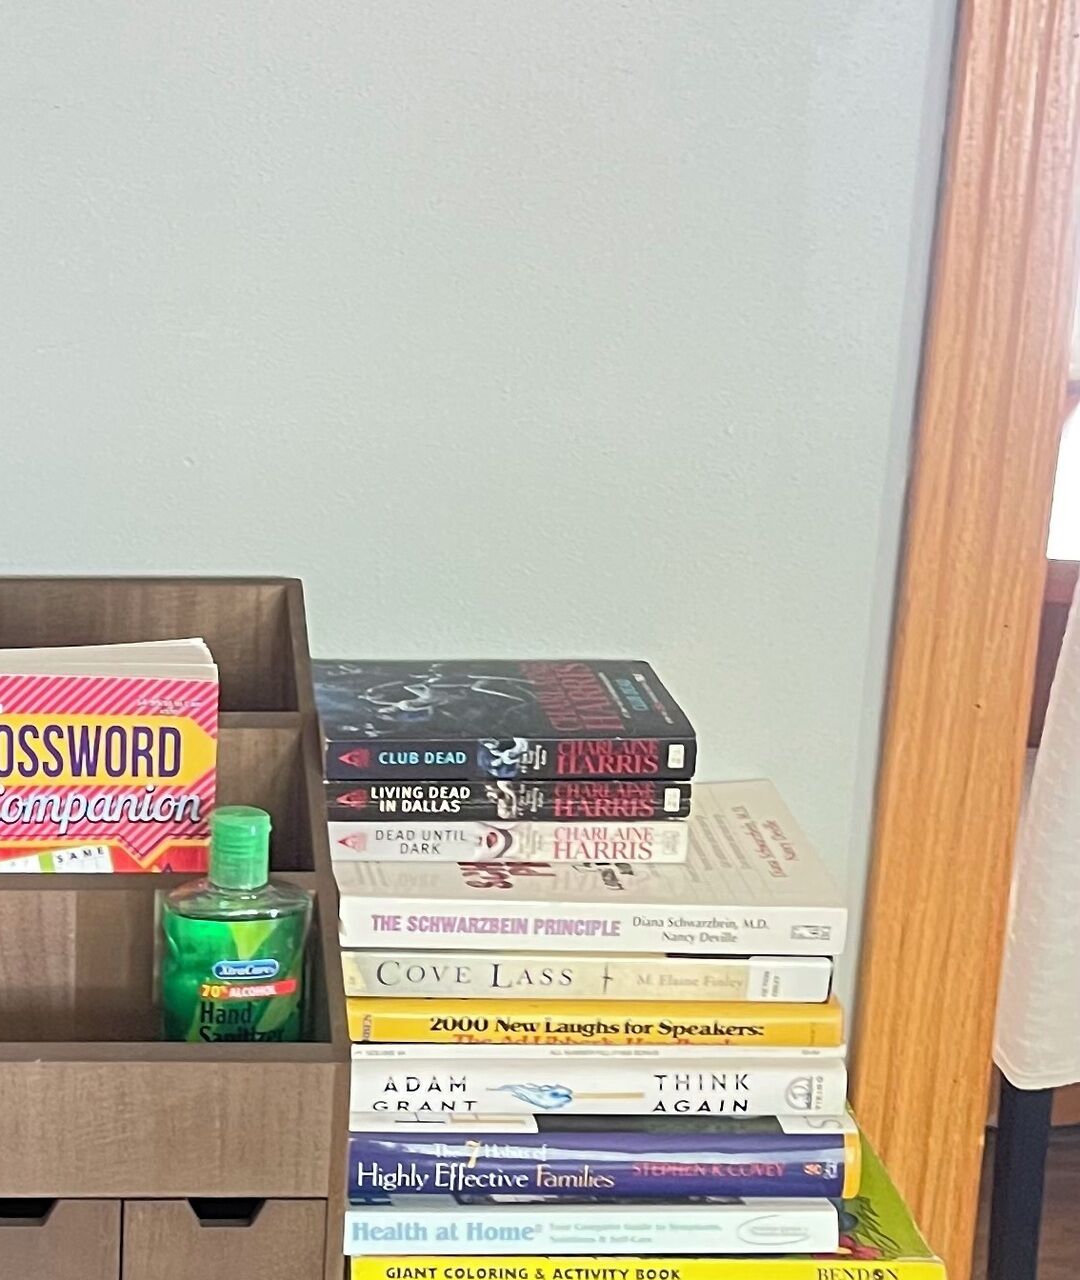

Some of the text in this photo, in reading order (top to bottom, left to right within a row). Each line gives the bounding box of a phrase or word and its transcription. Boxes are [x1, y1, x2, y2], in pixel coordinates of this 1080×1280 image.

[558, 739, 660, 756] CHARLAINE
[378, 751, 467, 765] CLUB DEAD
[556, 754, 659, 775] HARRIS
[371, 786, 471, 800] LIVING DEAD
[554, 782, 655, 799] CHARLAINE
[379, 800, 462, 813] IN DALLAS
[553, 797, 655, 818] HARRIS
[375, 829, 468, 842] DEAD UNTIL
[554, 826, 654, 841] CHARLAINE
[57, 846, 105, 864] SAME
[400, 842, 442, 855] DARK
[553, 840, 653, 860] HARRIS
[371, 914, 621, 938] THE SCHWARZBEIN PRINCIPLE
[632, 916, 665, 928] Diana
[743, 919, 770, 930] M.D.
[662, 932, 738, 945] Nancy Deville
[376, 960, 574, 989] COVE LASS
[659, 974, 700, 987] Elaine
[229, 984, 278, 998] ALCOHOL
[200, 1001, 253, 1024] Hand
[429, 1016, 765, 1038] 2000 New Laughs for Speakers:
[384, 1076, 467, 1093] ADAM
[653, 1073, 750, 1092] THINK
[372, 1100, 479, 1112] GRANT
[652, 1099, 749, 1113] AGAIN
[465, 1140, 481, 1169] 7
[357, 1161, 615, 1192] Highly Effective Families
[632, 1162, 707, 1177] STEPHEN
[727, 1162, 787, 1177] COVEY
[351, 1222, 428, 1242] Health
[435, 1222, 460, 1242] at
[386, 1267, 681, 1280] GIANT COLORING & ACTIVITY BOOK
